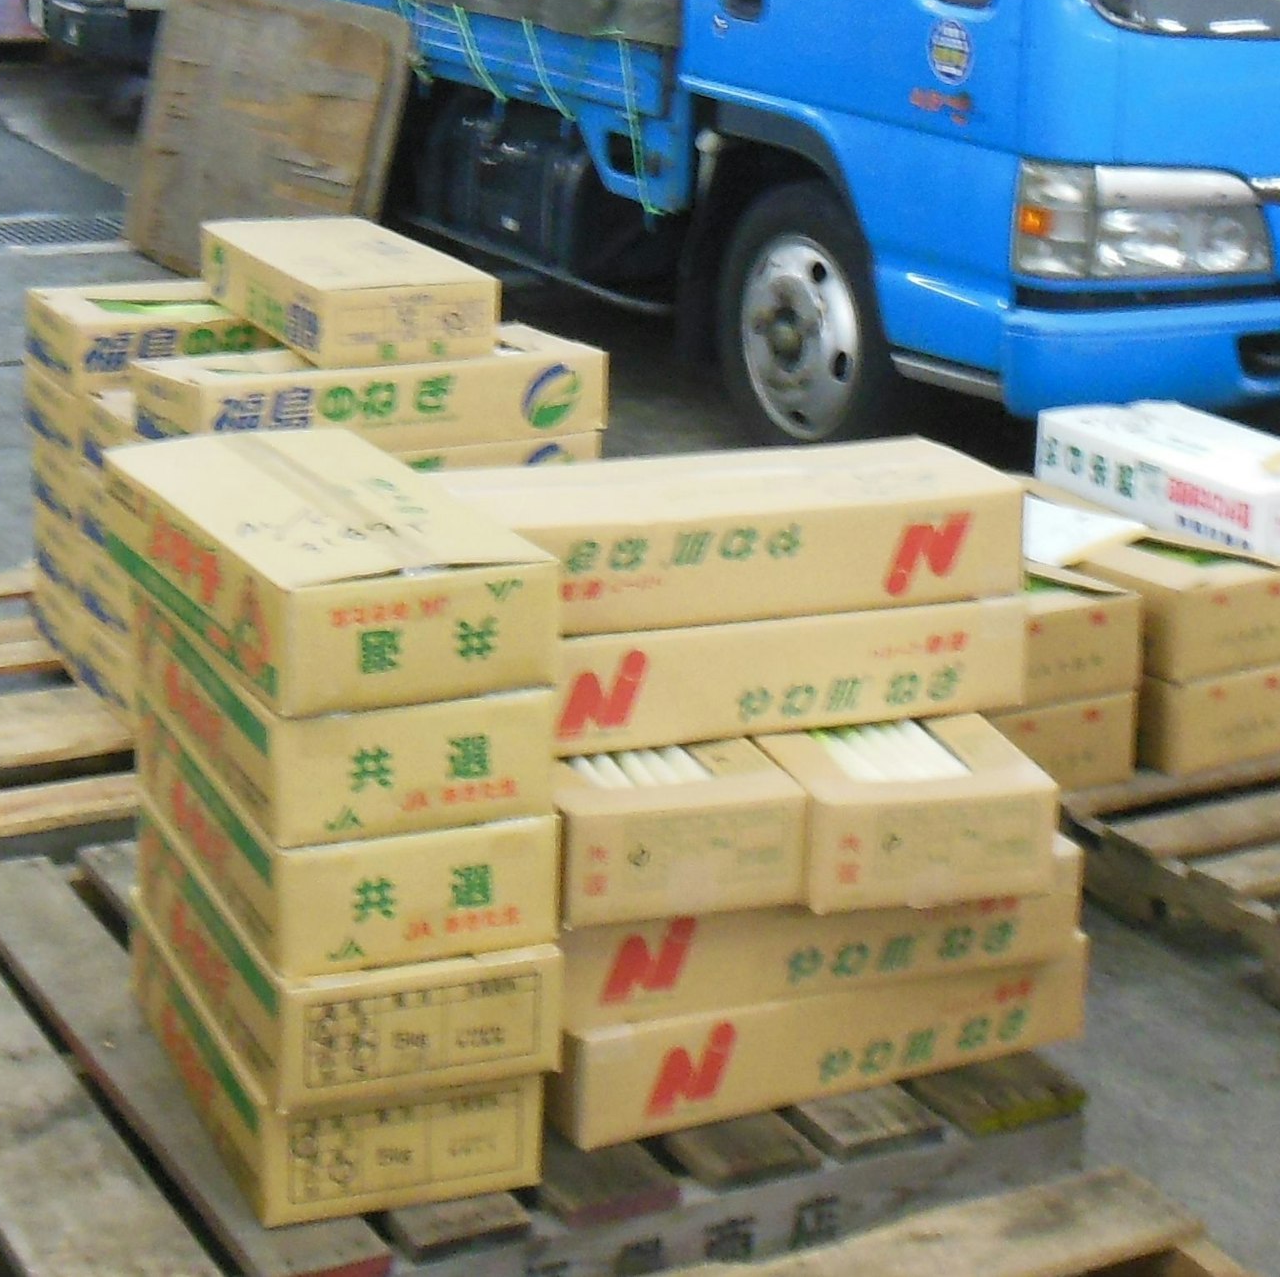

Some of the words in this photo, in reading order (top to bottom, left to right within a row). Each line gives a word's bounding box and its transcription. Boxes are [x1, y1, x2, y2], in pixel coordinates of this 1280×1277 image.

[214, 374, 454, 432] 福島のねぎ
[349, 733, 490, 793] 共選
[352, 864, 492, 923] 共選
